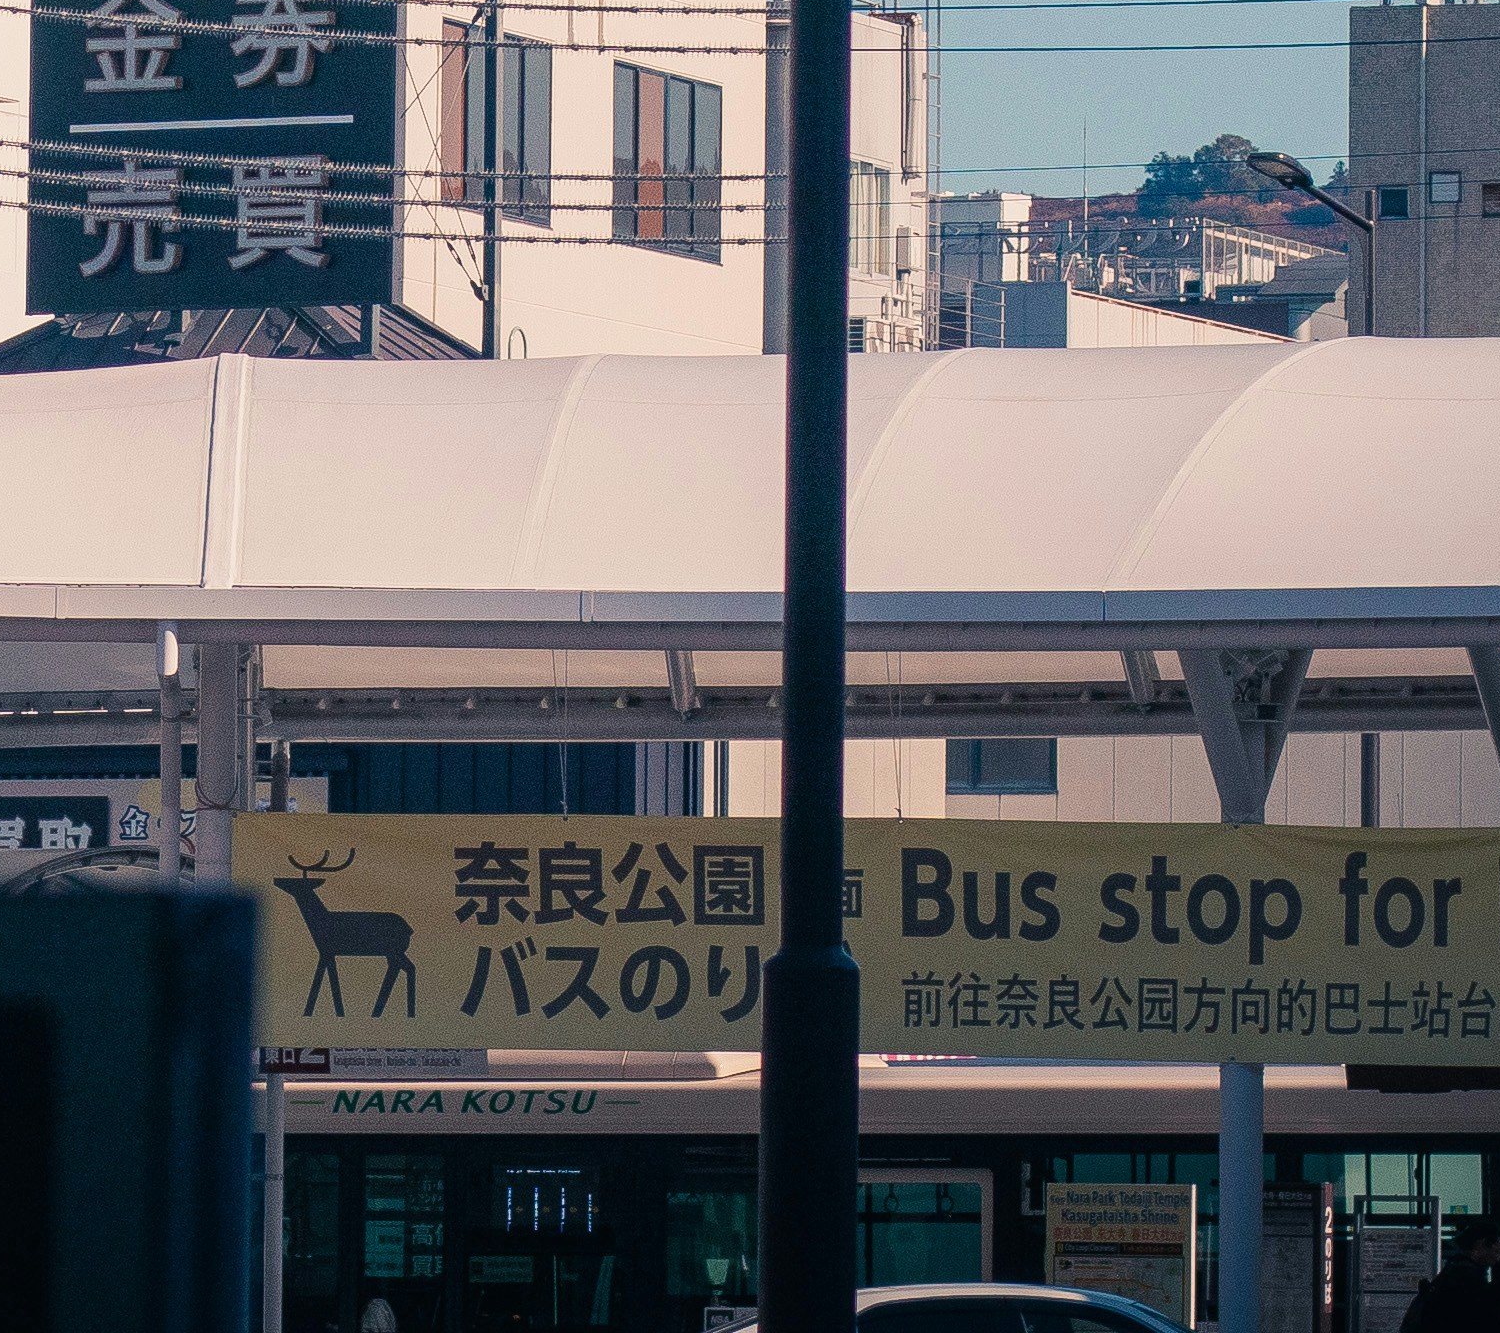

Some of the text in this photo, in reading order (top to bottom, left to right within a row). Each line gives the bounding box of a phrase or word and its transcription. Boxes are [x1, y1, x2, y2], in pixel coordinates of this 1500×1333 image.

[79, 153, 330, 277] 売買
[902, 847, 1062, 943] Bus
[1098, 854, 1304, 965] stop
[1340, 851, 1462, 948] for
[460, 937, 765, 1023] バスのり
[332, 1090, 598, 1115] NARA KOTSU
[1067, 1191, 1090, 1204] Nara
[1154, 1192, 1190, 1209] Temple
[1324, 1206, 1333, 1304] 2のりば
